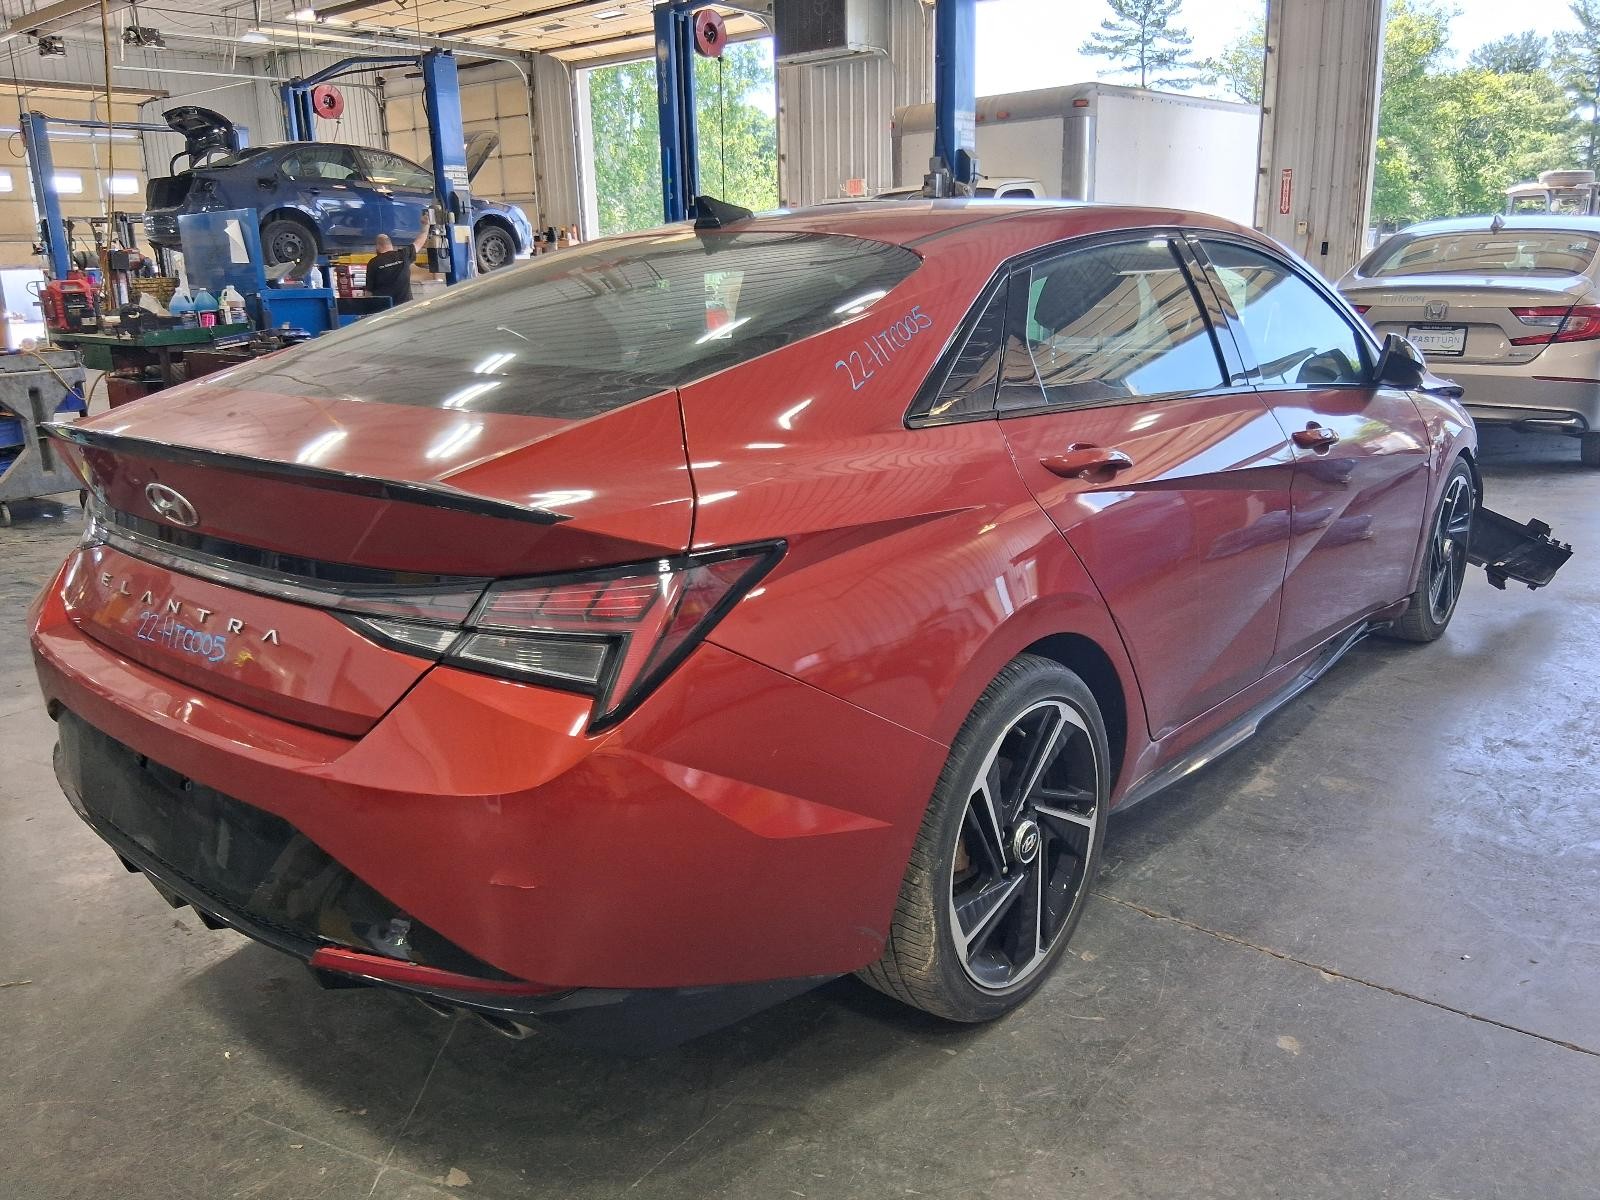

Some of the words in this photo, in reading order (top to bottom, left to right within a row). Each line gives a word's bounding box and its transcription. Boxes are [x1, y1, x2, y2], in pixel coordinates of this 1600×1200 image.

[835, 305, 932, 391] 22-HTC005
[101, 571, 281, 646] ELANTRA
[136, 611, 227, 662] 22-HTC005
